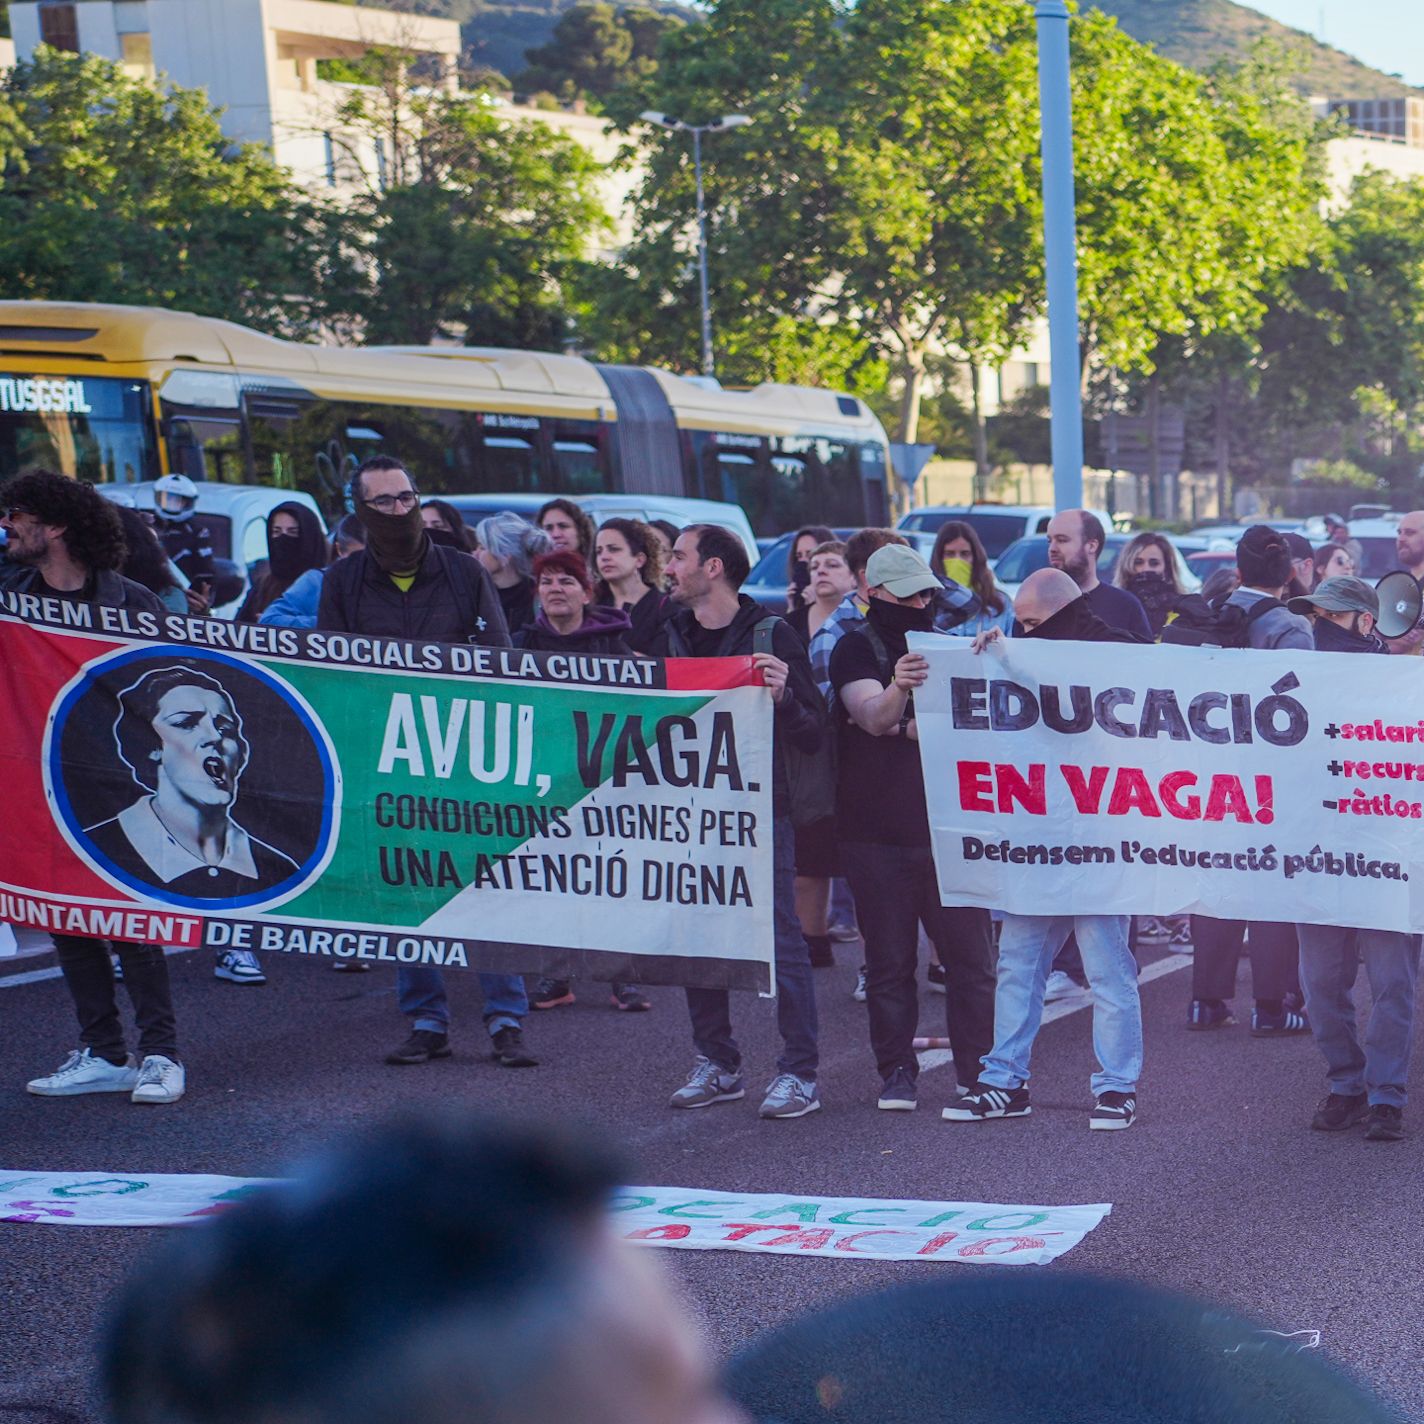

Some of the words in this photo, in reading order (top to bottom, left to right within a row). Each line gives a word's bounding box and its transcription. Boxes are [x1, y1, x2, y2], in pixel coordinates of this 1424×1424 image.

[100, 605, 160, 637] ELS
[165, 614, 299, 656] SERVEIS
[306, 632, 443, 672] SOCIALS
[451, 646, 493, 674] DE
[500, 652, 542, 679] LA
[547, 655, 657, 685] CIUTAT
[950, 671, 1309, 747] EDUCACIÓ
[378, 692, 551, 797] AVUI,
[572, 710, 761, 792] VAGA.
[375, 792, 570, 839] CONDICIONS
[583, 806, 691, 845] DIGNES
[698, 810, 757, 847] PER
[956, 760, 1047, 815] EN
[1060, 764, 1275, 825] VAGA!
[379, 846, 463, 890] UNA
[474, 848, 627, 898] ATENCIÓ
[643, 860, 753, 907] DIGNA
[962, 835, 1115, 865] Defensem
[1121, 840, 1278, 871] l'educació
[206, 921, 253, 948] DE
[261, 926, 468, 967] BARCELONA
